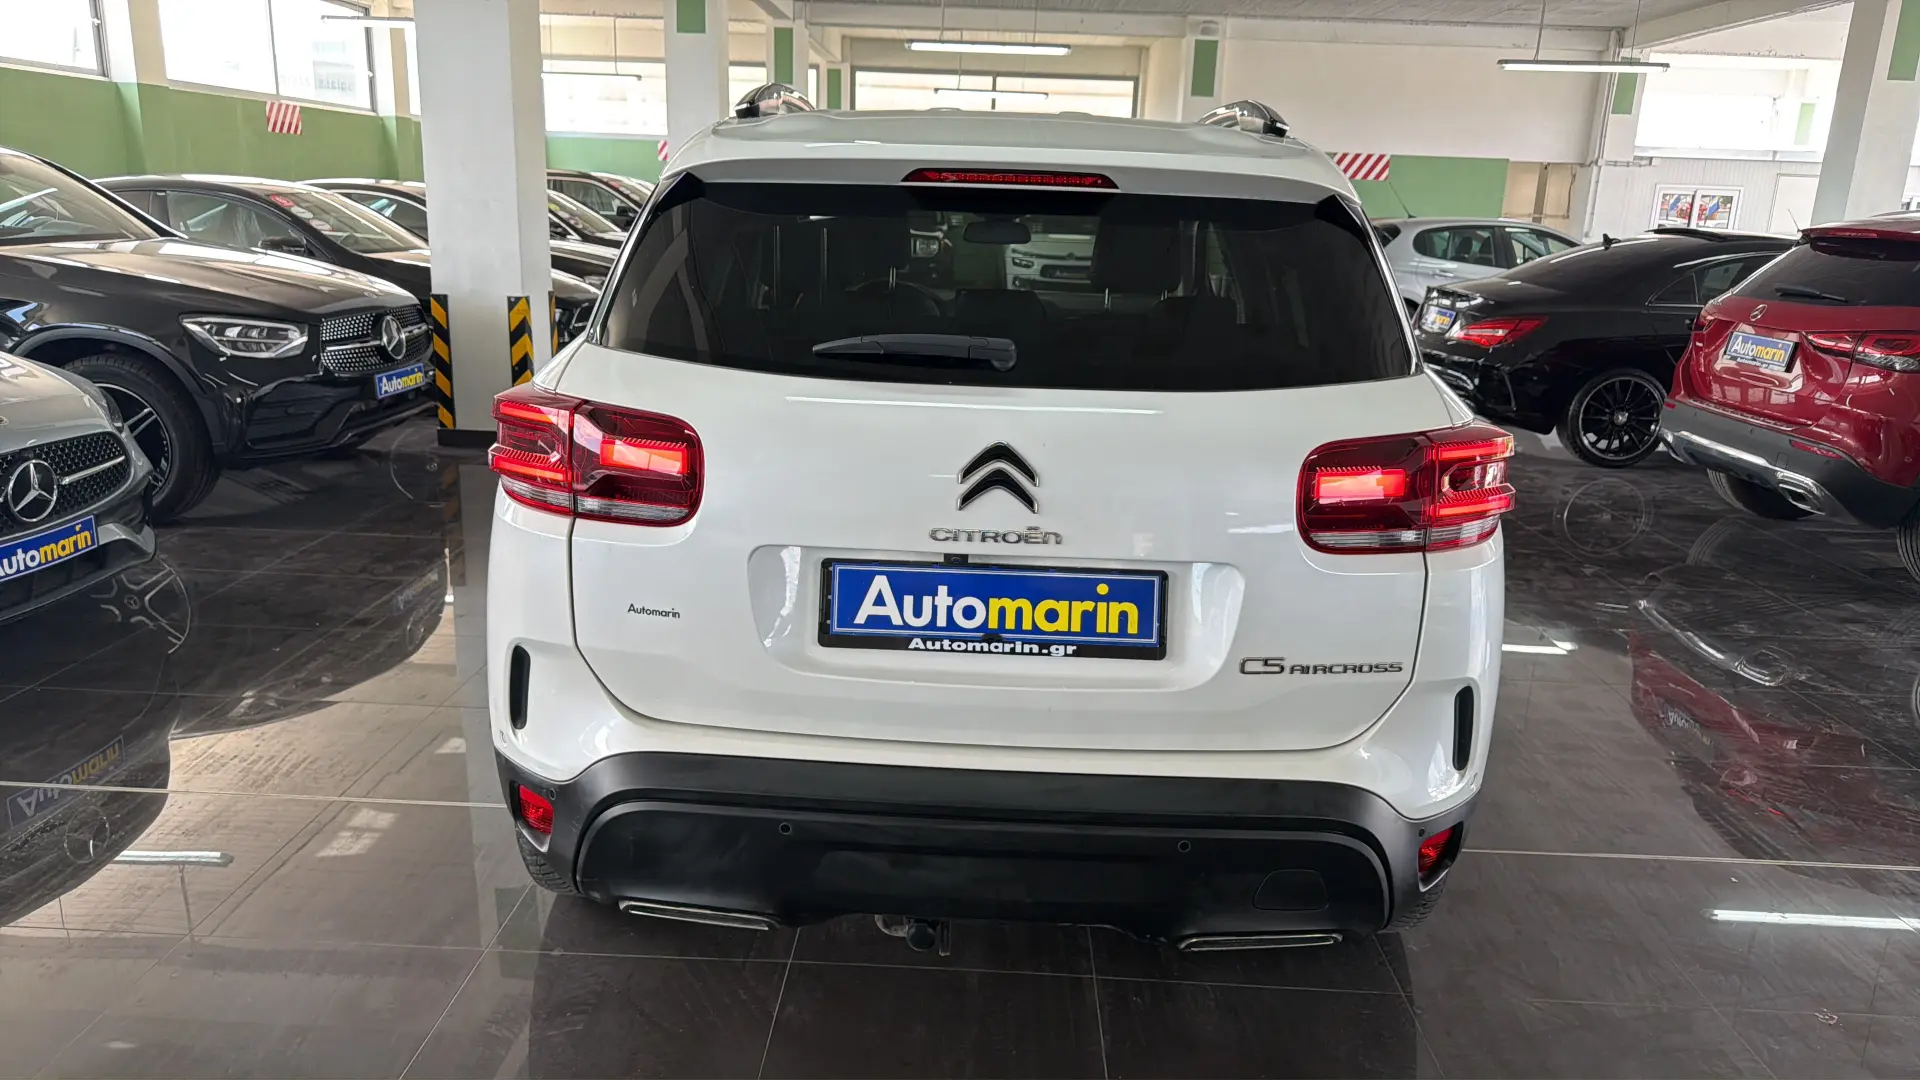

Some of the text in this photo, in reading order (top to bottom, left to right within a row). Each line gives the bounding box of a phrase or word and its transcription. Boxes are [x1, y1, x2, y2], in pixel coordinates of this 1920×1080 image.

[1730, 335, 1785, 362] Automarin
[381, 367, 423, 395] Automarin
[929, 526, 1063, 545] CITROËN
[627, 602, 681, 619] Automarin
[853, 574, 1139, 635] Automarin
[908, 637, 1077, 656] Automarin.gr
[1239, 656, 1403, 675] C5 AIRCROSS
